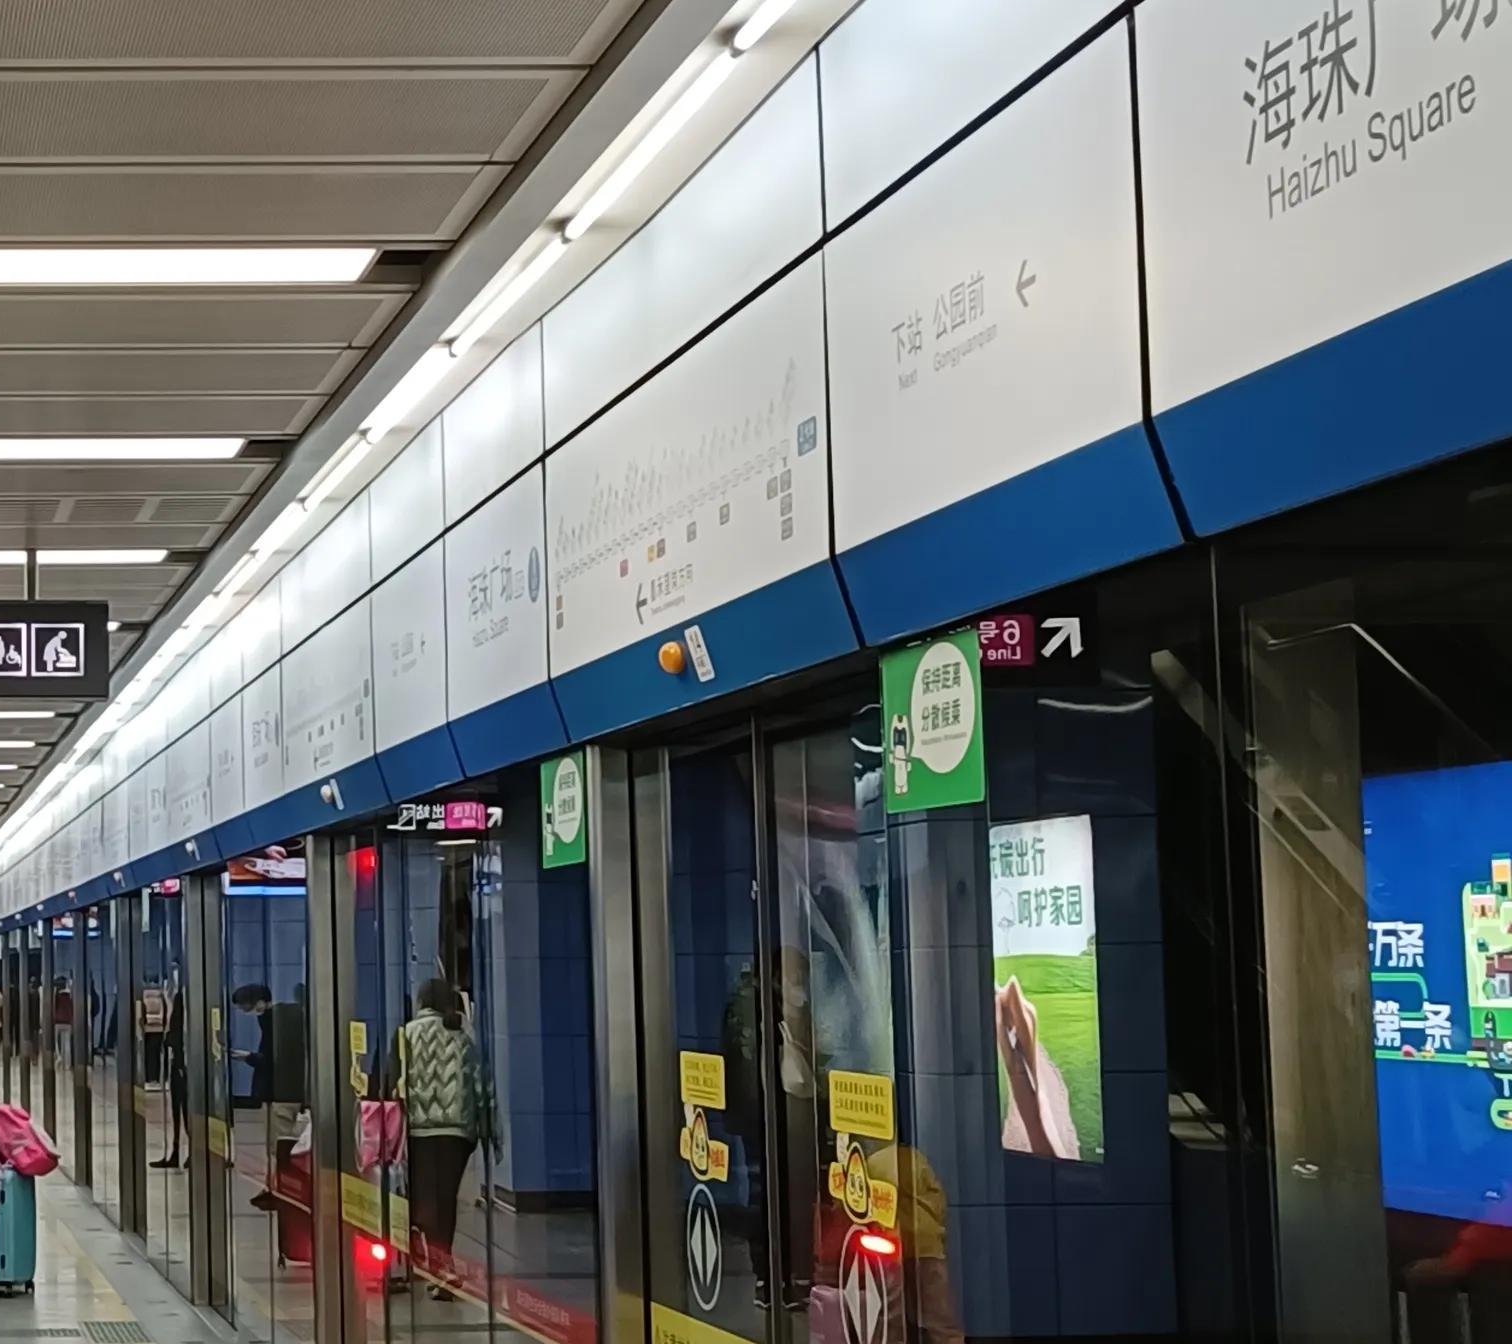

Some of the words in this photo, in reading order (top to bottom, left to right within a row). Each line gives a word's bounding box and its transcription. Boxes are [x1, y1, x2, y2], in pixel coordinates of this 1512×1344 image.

[1267, 138, 1358, 220] Haizhu
[1368, 74, 1476, 163] Square
[891, 308, 923, 364] 下站
[933, 269, 984, 340] 公园前
[1017, 885, 1083, 928] 呵护家园
[1368, 920, 1424, 968] 万条
[1373, 1000, 1452, 1050] 第一条
